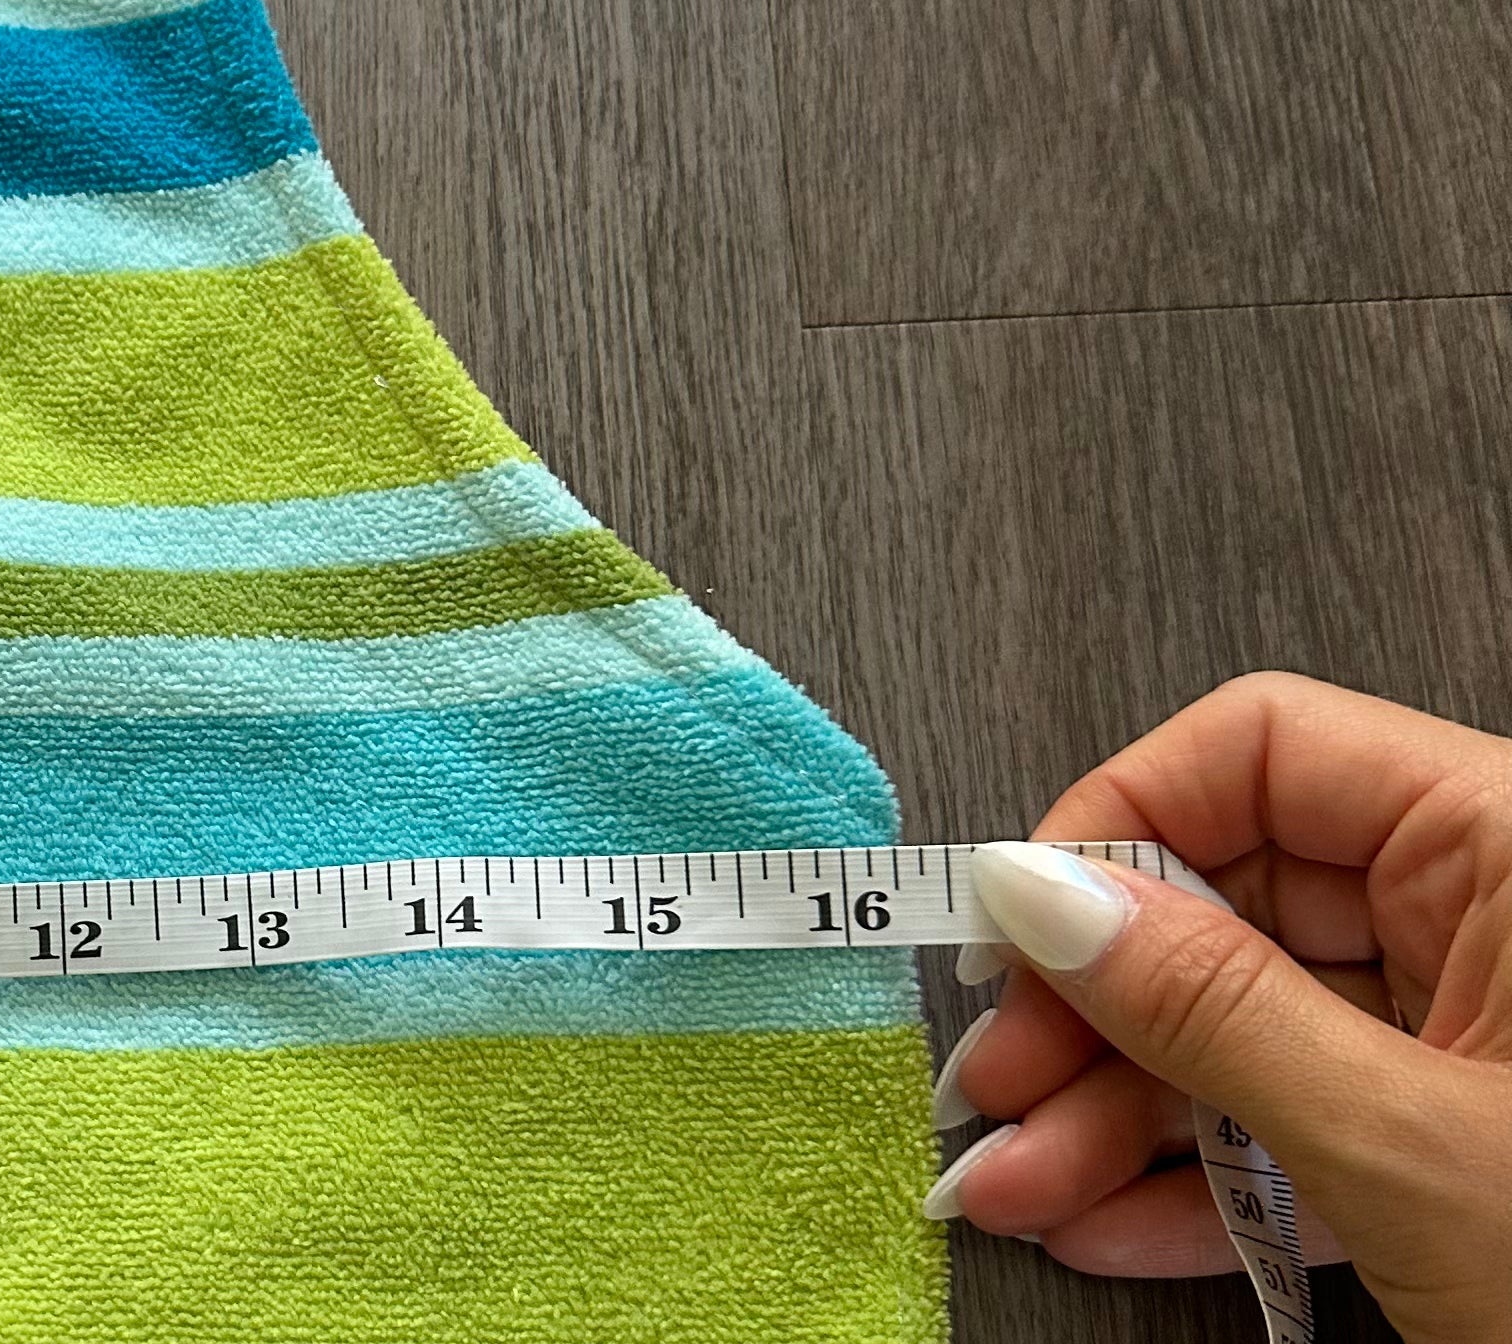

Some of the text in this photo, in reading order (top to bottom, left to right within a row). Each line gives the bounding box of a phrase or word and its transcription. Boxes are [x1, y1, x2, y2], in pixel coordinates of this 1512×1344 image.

[29, 920, 103, 961] 12
[217, 911, 290, 952] 13
[403, 895, 483, 937] 14
[602, 895, 682, 935] 15
[807, 890, 891, 932] 16
[1228, 1186, 1265, 1225] 50
[1257, 1257, 1292, 1298] 51
